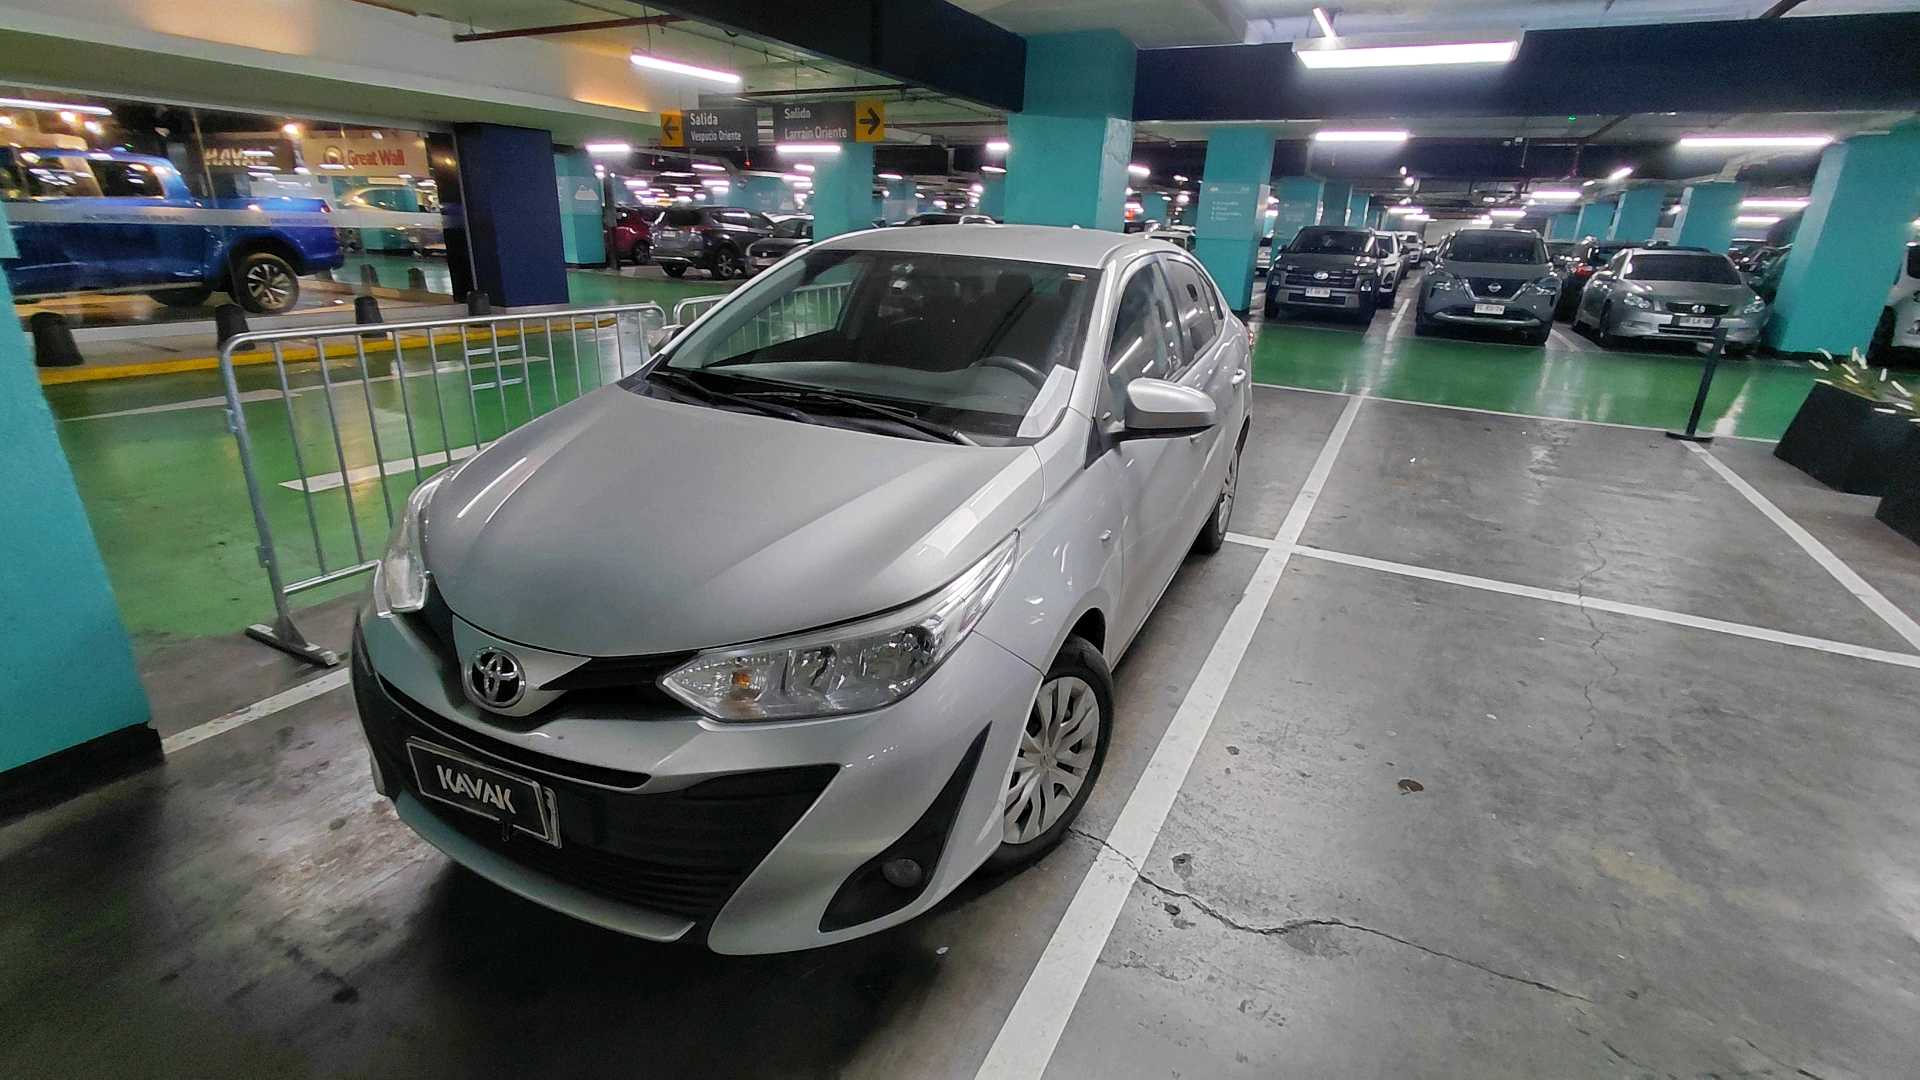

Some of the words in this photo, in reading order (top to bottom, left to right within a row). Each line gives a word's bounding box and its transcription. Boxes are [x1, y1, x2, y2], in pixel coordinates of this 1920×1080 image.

[690, 112, 718, 126] Salida
[784, 107, 811, 119] Salida
[691, 130, 717, 143] Vespucio
[718, 130, 742, 142] Oriente
[815, 126, 848, 139] Oriente
[347, 149, 377, 166] Great
[378, 149, 405, 166] Wall
[436, 765, 517, 815] KAVAK
